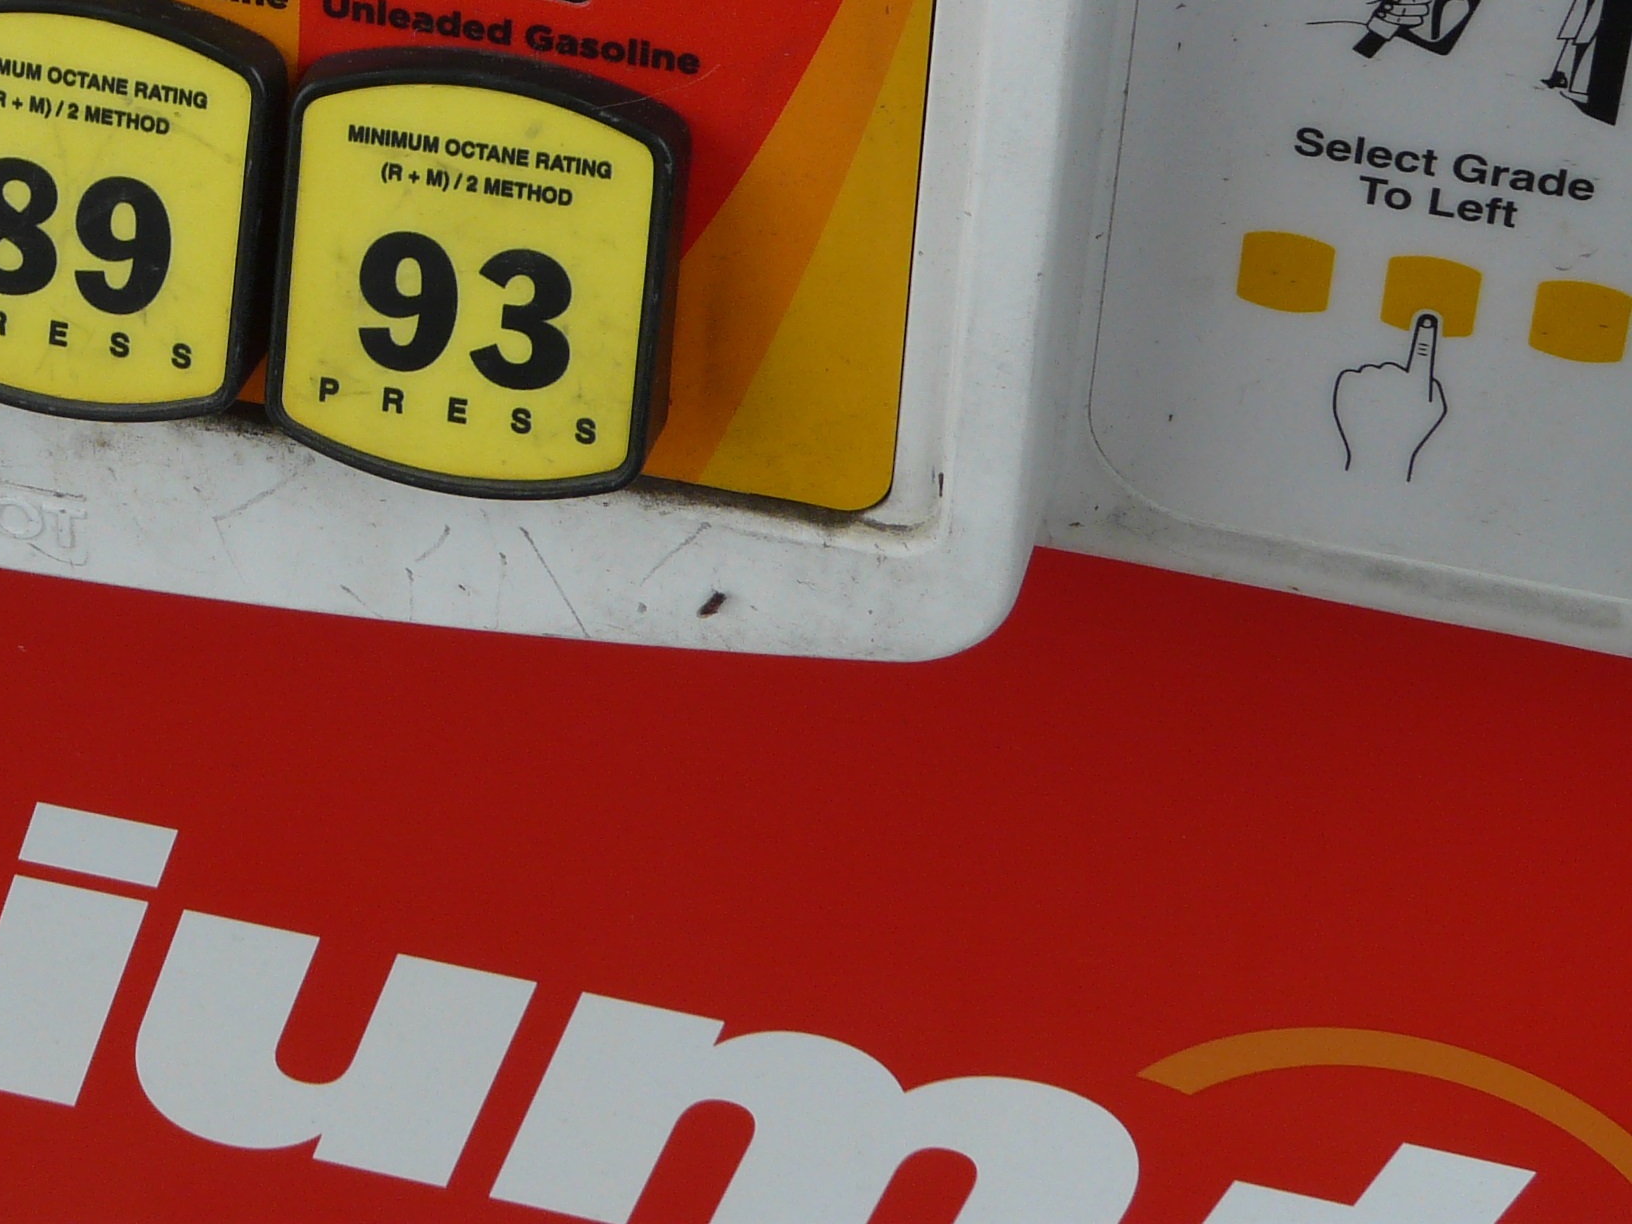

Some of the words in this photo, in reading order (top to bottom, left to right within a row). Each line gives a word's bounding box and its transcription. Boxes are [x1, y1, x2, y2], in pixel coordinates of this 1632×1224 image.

[525, 23, 701, 75] Gasoline
[47, 65, 129, 96] OCTANE
[134, 80, 208, 109] RATING
[67, 102, 79, 121] 2
[84, 105, 170, 135] METHOD
[348, 124, 440, 154] MINIMUM
[444, 139, 530, 167] OCTANE
[536, 151, 612, 180] RATING
[1294, 126, 1438, 177] Select
[1453, 153, 1595, 201] Grade
[466, 175, 478, 193] 2
[483, 177, 573, 207] METHOD
[1360, 175, 1412, 210] To
[1428, 187, 1519, 228] Left
[358, 230, 572, 391] 93
